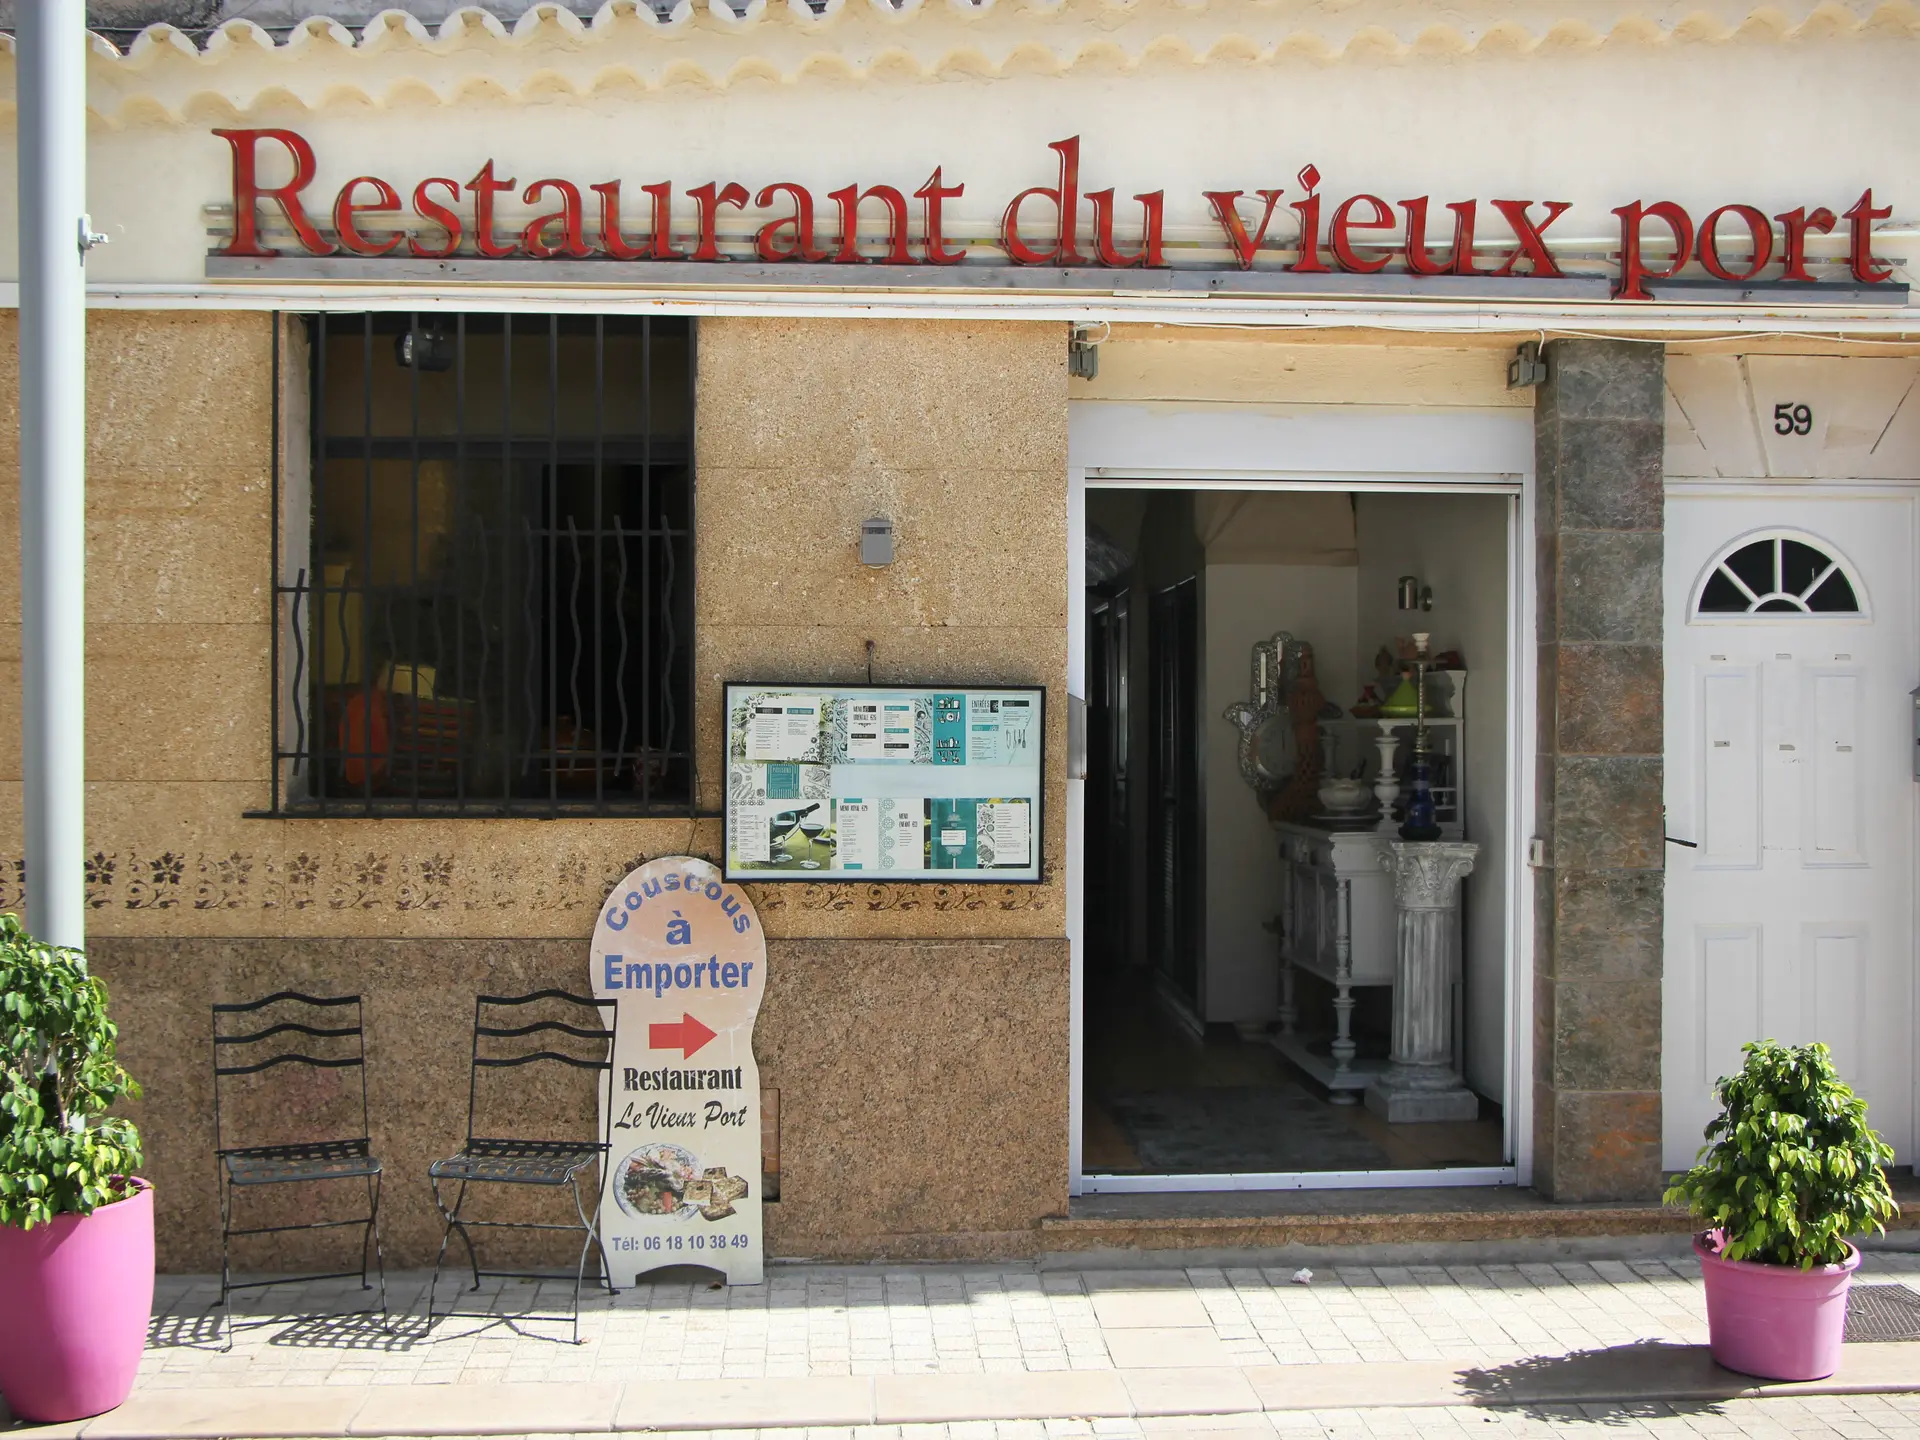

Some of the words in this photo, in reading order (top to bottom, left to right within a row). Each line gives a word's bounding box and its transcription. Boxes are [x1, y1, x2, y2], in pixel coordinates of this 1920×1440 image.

[212, 127, 967, 266] Restaurant
[1000, 134, 1164, 269] du
[1202, 163, 1573, 279] vieux
[1609, 187, 1894, 300] port
[1774, 402, 1812, 436] 59
[971, 699, 990, 708] ENTRÉES
[605, 872, 751, 934] Couscous
[665, 910, 692, 945] à
[604, 954, 754, 998] Emporter
[623, 1066, 743, 1091] Restaurant
[614, 1101, 642, 1129] Le
[645, 1102, 697, 1130] Vieux
[703, 1100, 748, 1130] Port
[612, 1236, 639, 1251] Tél:
[643, 1236, 661, 1250] 06
[666, 1235, 683, 1250] 18
[688, 1235, 705, 1249] 10
[709, 1234, 726, 1249] 38
[731, 1234, 748, 1249] 49
